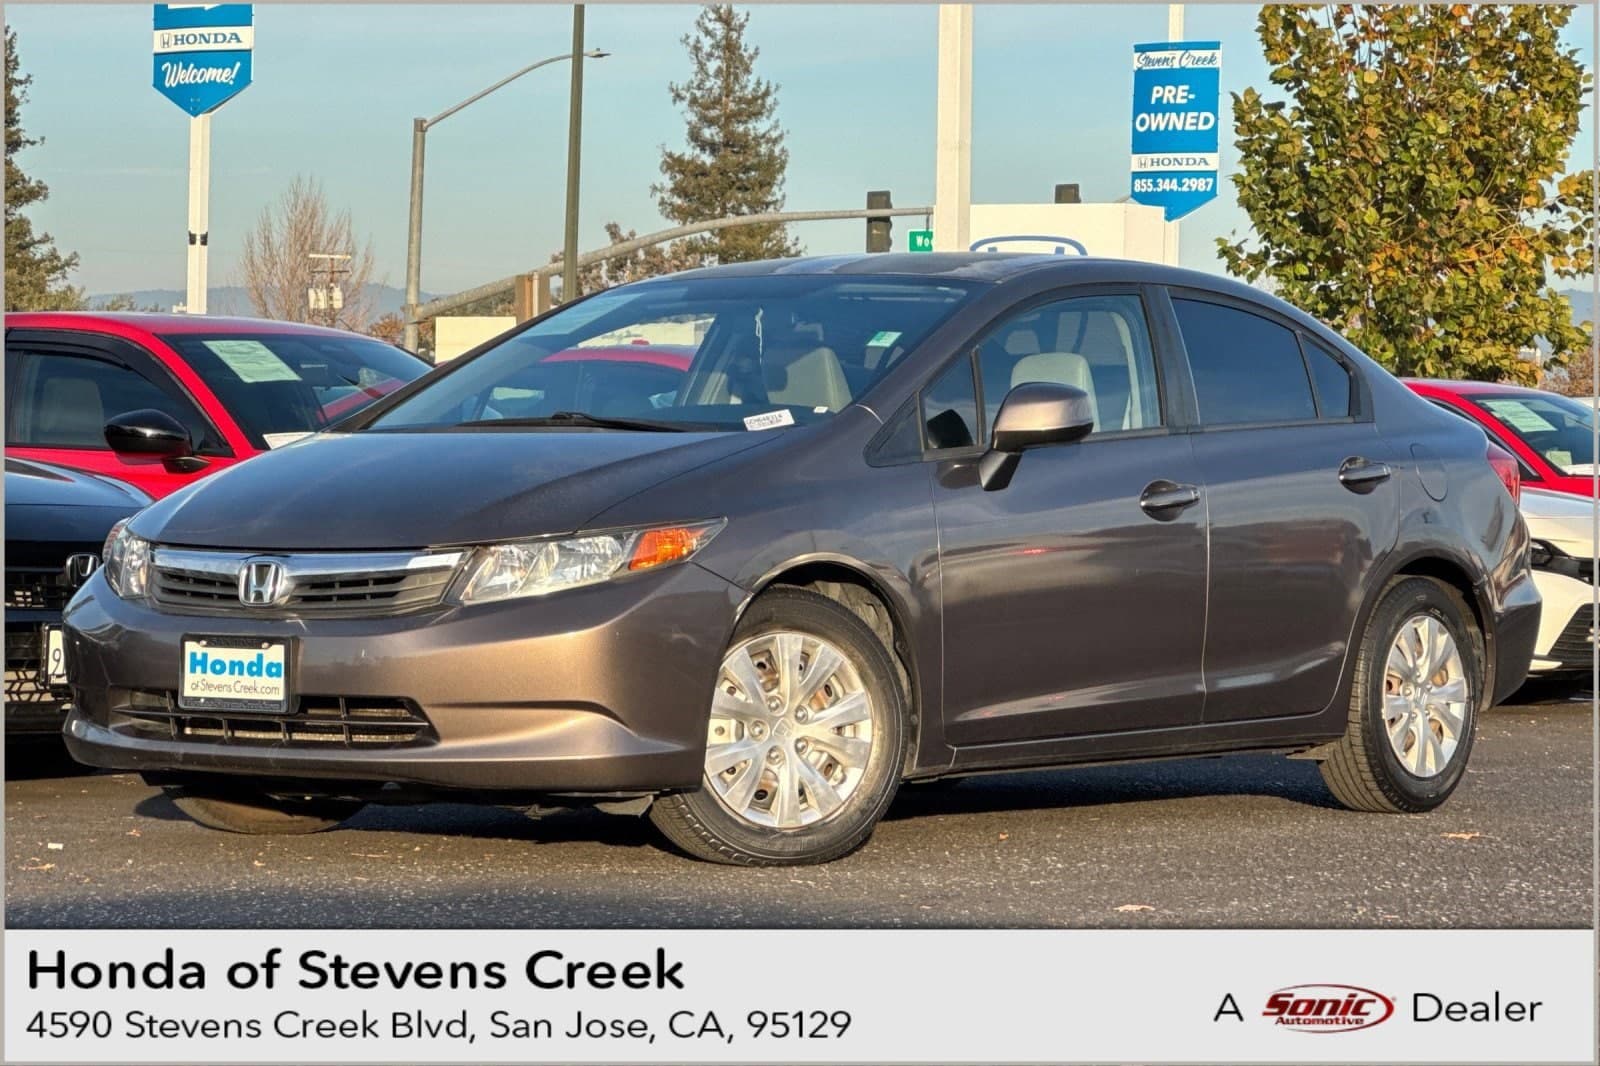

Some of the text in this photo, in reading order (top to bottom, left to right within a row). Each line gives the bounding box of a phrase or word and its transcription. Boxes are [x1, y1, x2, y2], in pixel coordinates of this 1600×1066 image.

[173, 32, 242, 46] HONDA
[1136, 50, 1217, 69] Stevens Creek
[161, 61, 241, 88] Welcome!
[1150, 84, 1196, 105] PRE-
[1135, 111, 1216, 132] OWNED
[1150, 157, 1210, 167] HONDA
[1133, 177, 1214, 193] 855.344.2987
[189, 651, 283, 678] Honda
